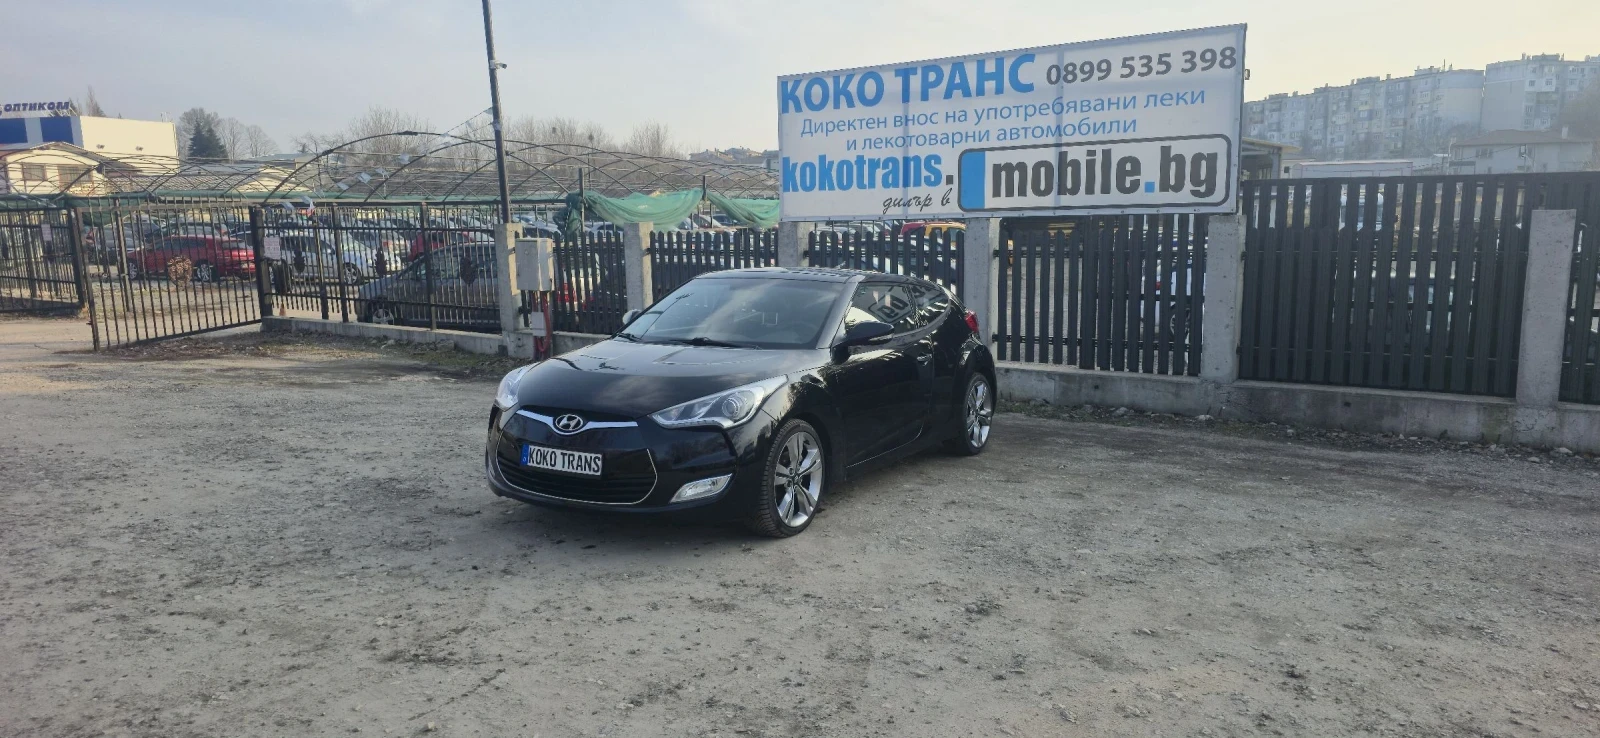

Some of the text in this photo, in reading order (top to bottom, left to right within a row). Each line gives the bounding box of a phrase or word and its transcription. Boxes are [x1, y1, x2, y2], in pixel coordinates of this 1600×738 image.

[781, 54, 1036, 114] КОКО ТРАНС
[1046, 47, 1236, 85] 0899 535 398
[800, 90, 1205, 137] Директен внос на употребявани леки
[846, 117, 1137, 151] и лекотоварни автомобили
[992, 145, 1218, 198] mobile.bg
[882, 193, 933, 214] дилър
[528, 447, 601, 473] KOKO TRANS
